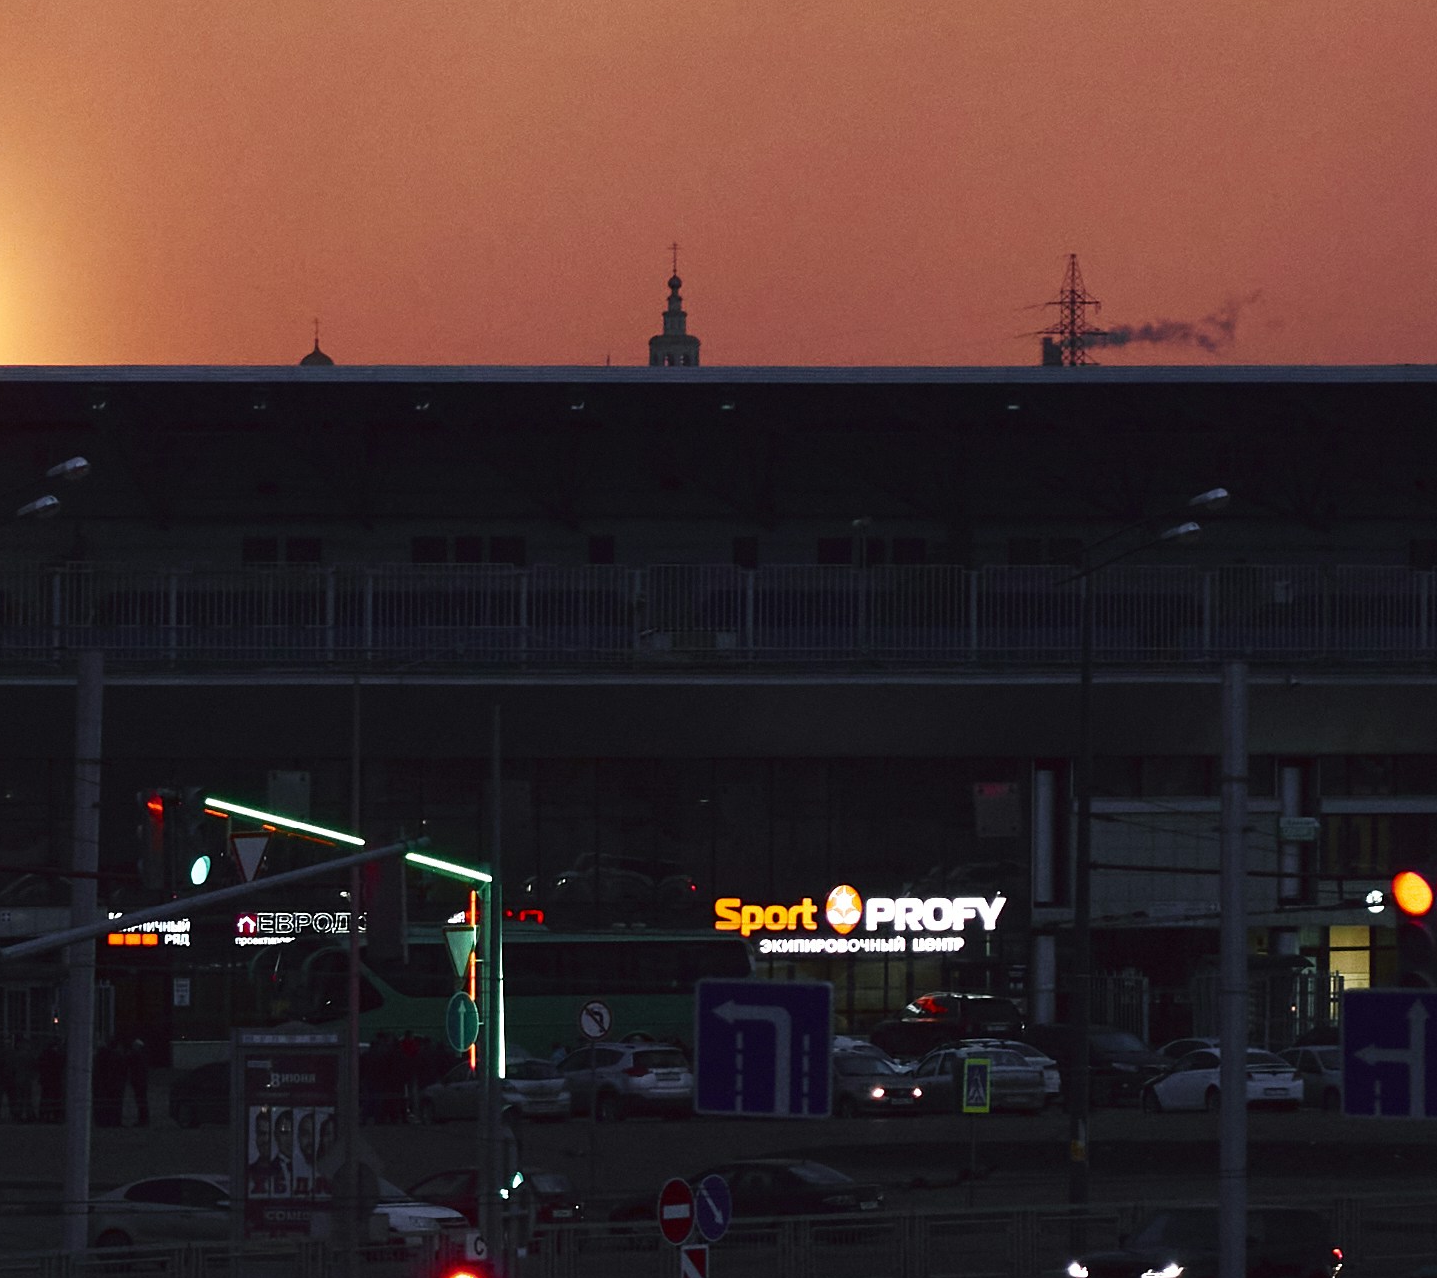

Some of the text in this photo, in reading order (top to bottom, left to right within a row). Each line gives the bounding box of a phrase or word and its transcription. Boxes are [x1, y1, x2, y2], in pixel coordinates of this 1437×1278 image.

[714, 897, 1007, 937] Sport PROFY
[164, 933, 190, 947] РЯД
[759, 936, 965, 953] ЭКИПИРОВОЧНЫЙ ЦЕНТР
